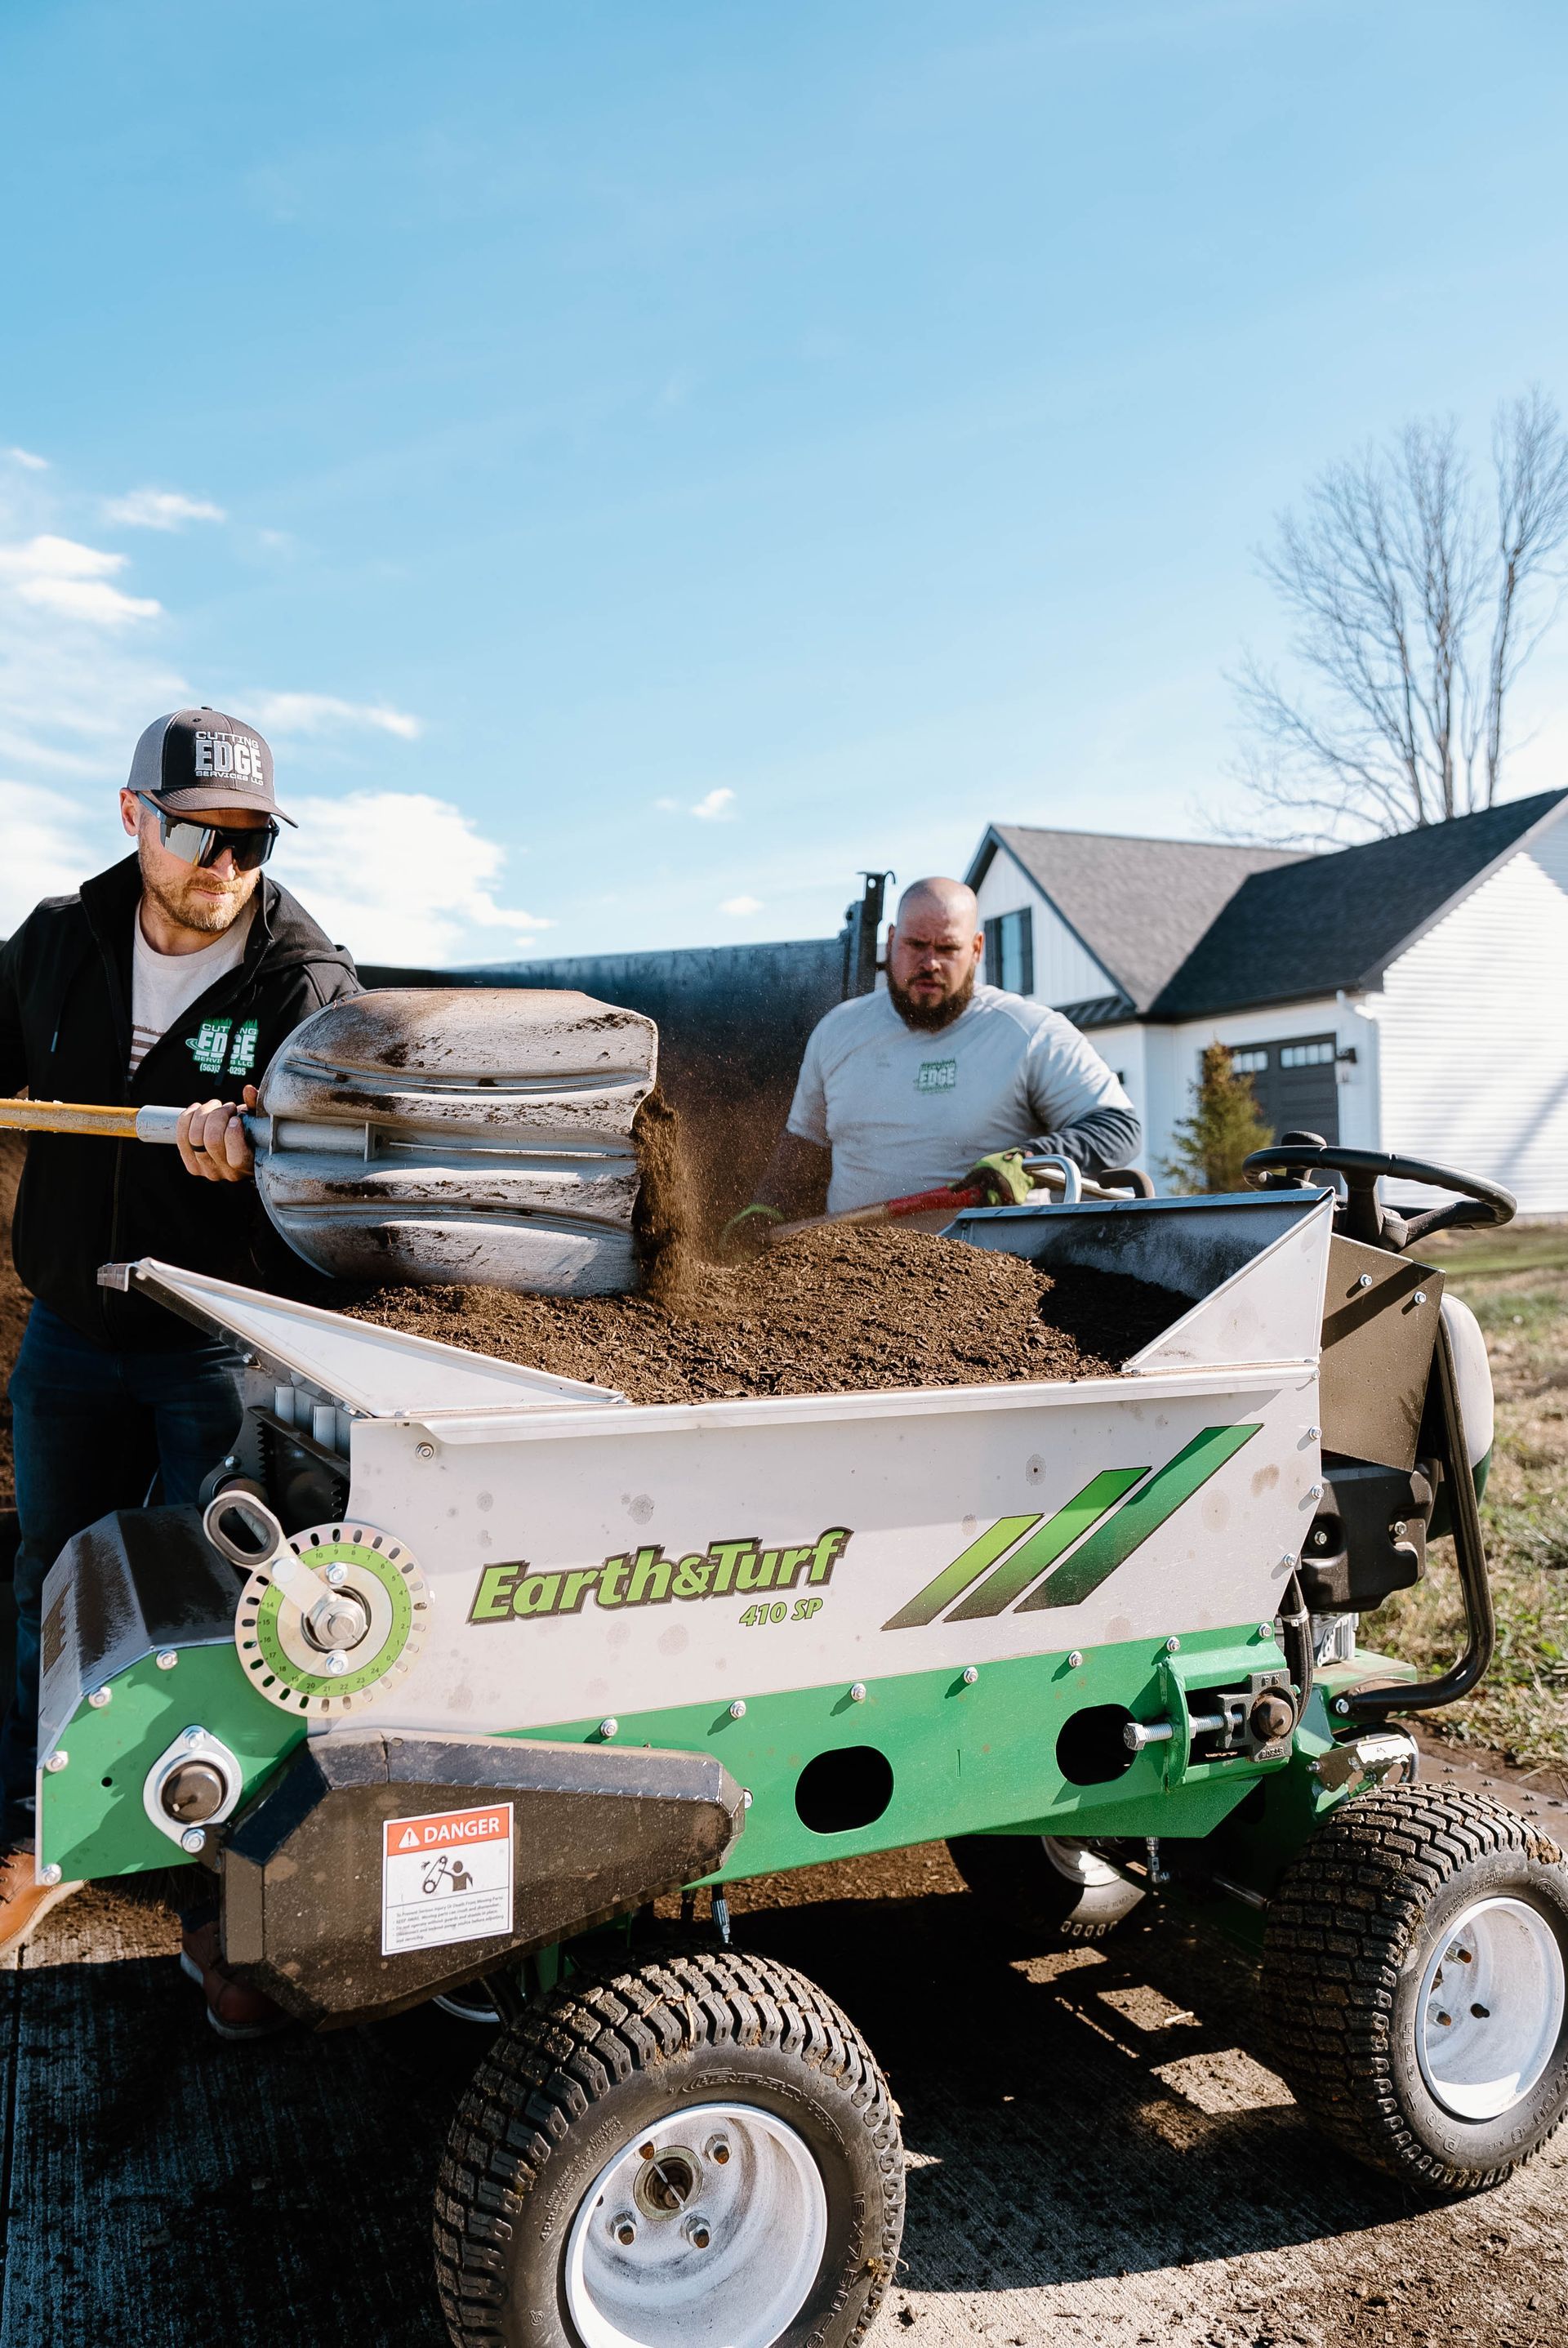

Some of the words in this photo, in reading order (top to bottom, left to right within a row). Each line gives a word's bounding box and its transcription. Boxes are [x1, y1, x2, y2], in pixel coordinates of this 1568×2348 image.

[195, 731, 259, 749] CUTTING
[195, 739, 263, 781] EDGE
[195, 770, 248, 782] SERVICES
[251, 777, 264, 786] LLC
[202, 1023, 257, 1036] CUTNG
[466, 1526, 854, 1625] Earth&Turf
[739, 1602, 787, 1626] 410
[791, 1597, 823, 1620] SP
[424, 1817, 500, 1843] DANGER
